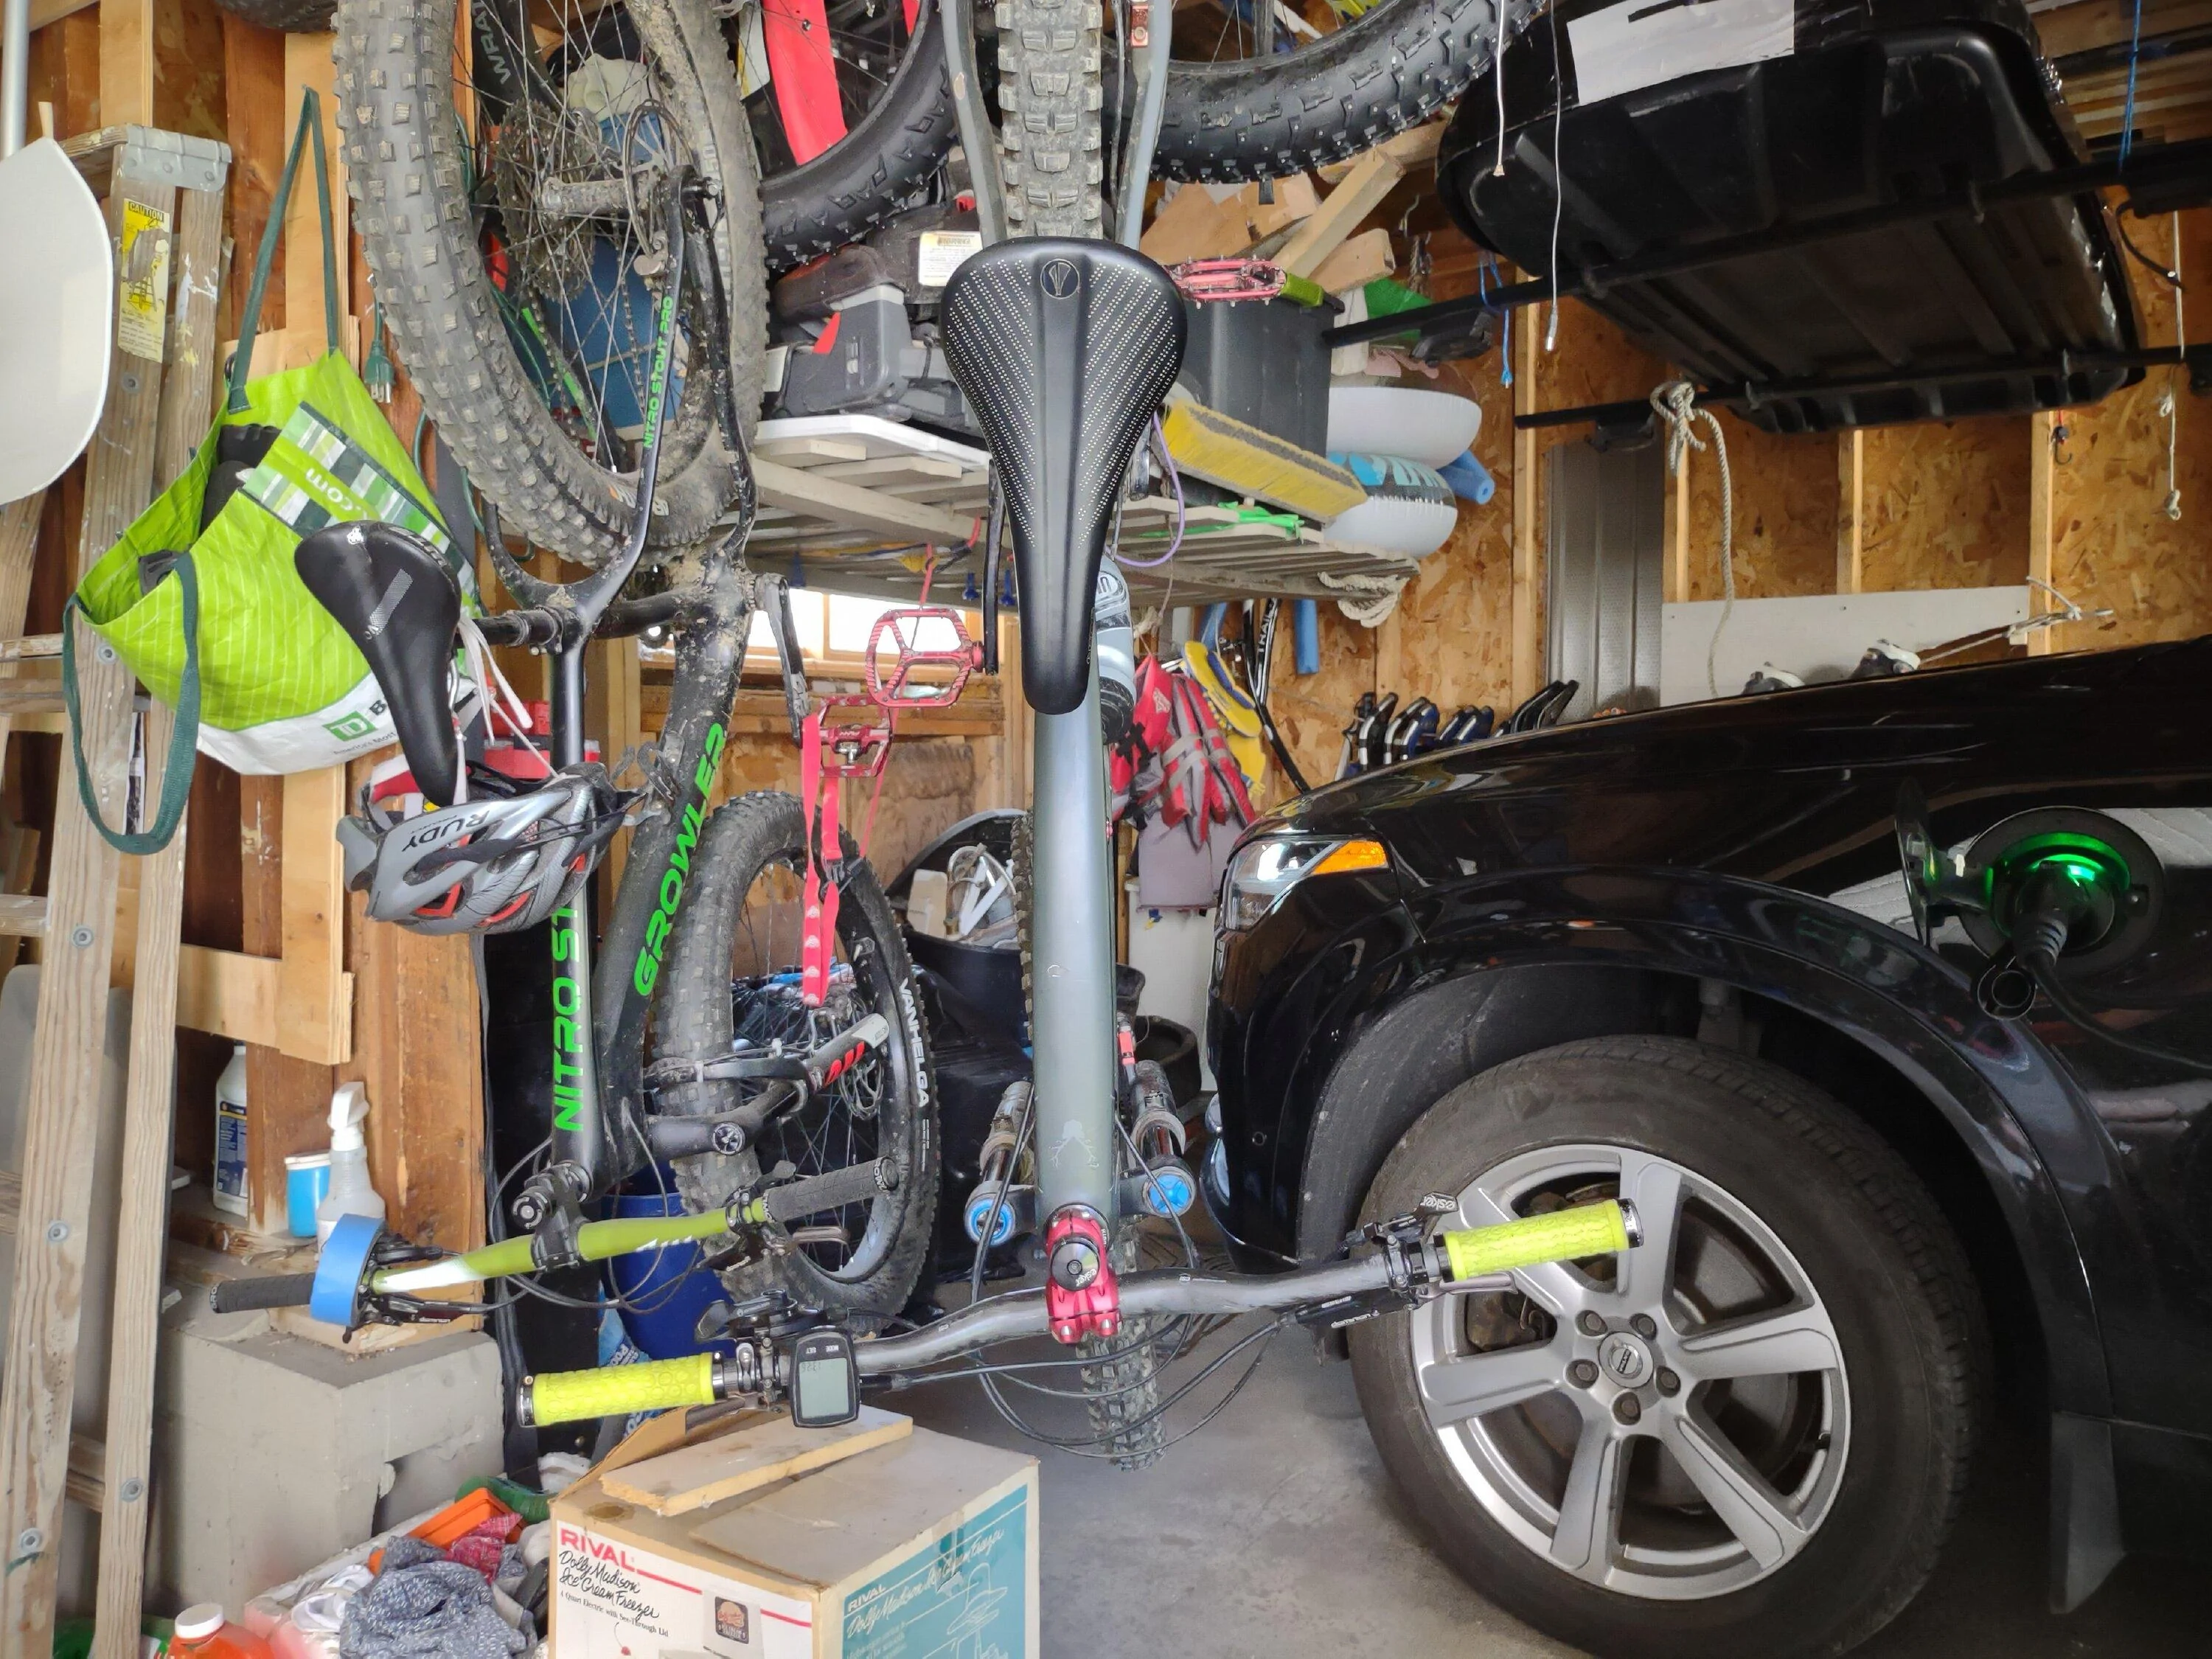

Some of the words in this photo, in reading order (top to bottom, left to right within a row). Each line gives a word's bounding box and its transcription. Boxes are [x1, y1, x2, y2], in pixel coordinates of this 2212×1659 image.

[130, 203, 163, 220] CAUTION
[659, 296, 674, 333] PRO
[651, 336, 667, 394] STOUT
[643, 397, 660, 448] NITRO
[402, 810, 490, 852] RUDY
[634, 723, 726, 995] GROWLER
[553, 976, 583, 1132] NITRO
[900, 976, 930, 1107] VANHELGA
[1420, 1194, 1455, 1210] esker
[1075, 1267, 1097, 1287] esker
[559, 1550, 592, 1579] Dolly
[561, 1528, 635, 1572] RIVAL
[559, 1568, 580, 1587] Ice
[581, 1577, 615, 1606] Cream
[616, 1590, 659, 1623] Freezer
[605, 1609, 618, 1618] with
[848, 1584, 886, 1612] RIVAL
